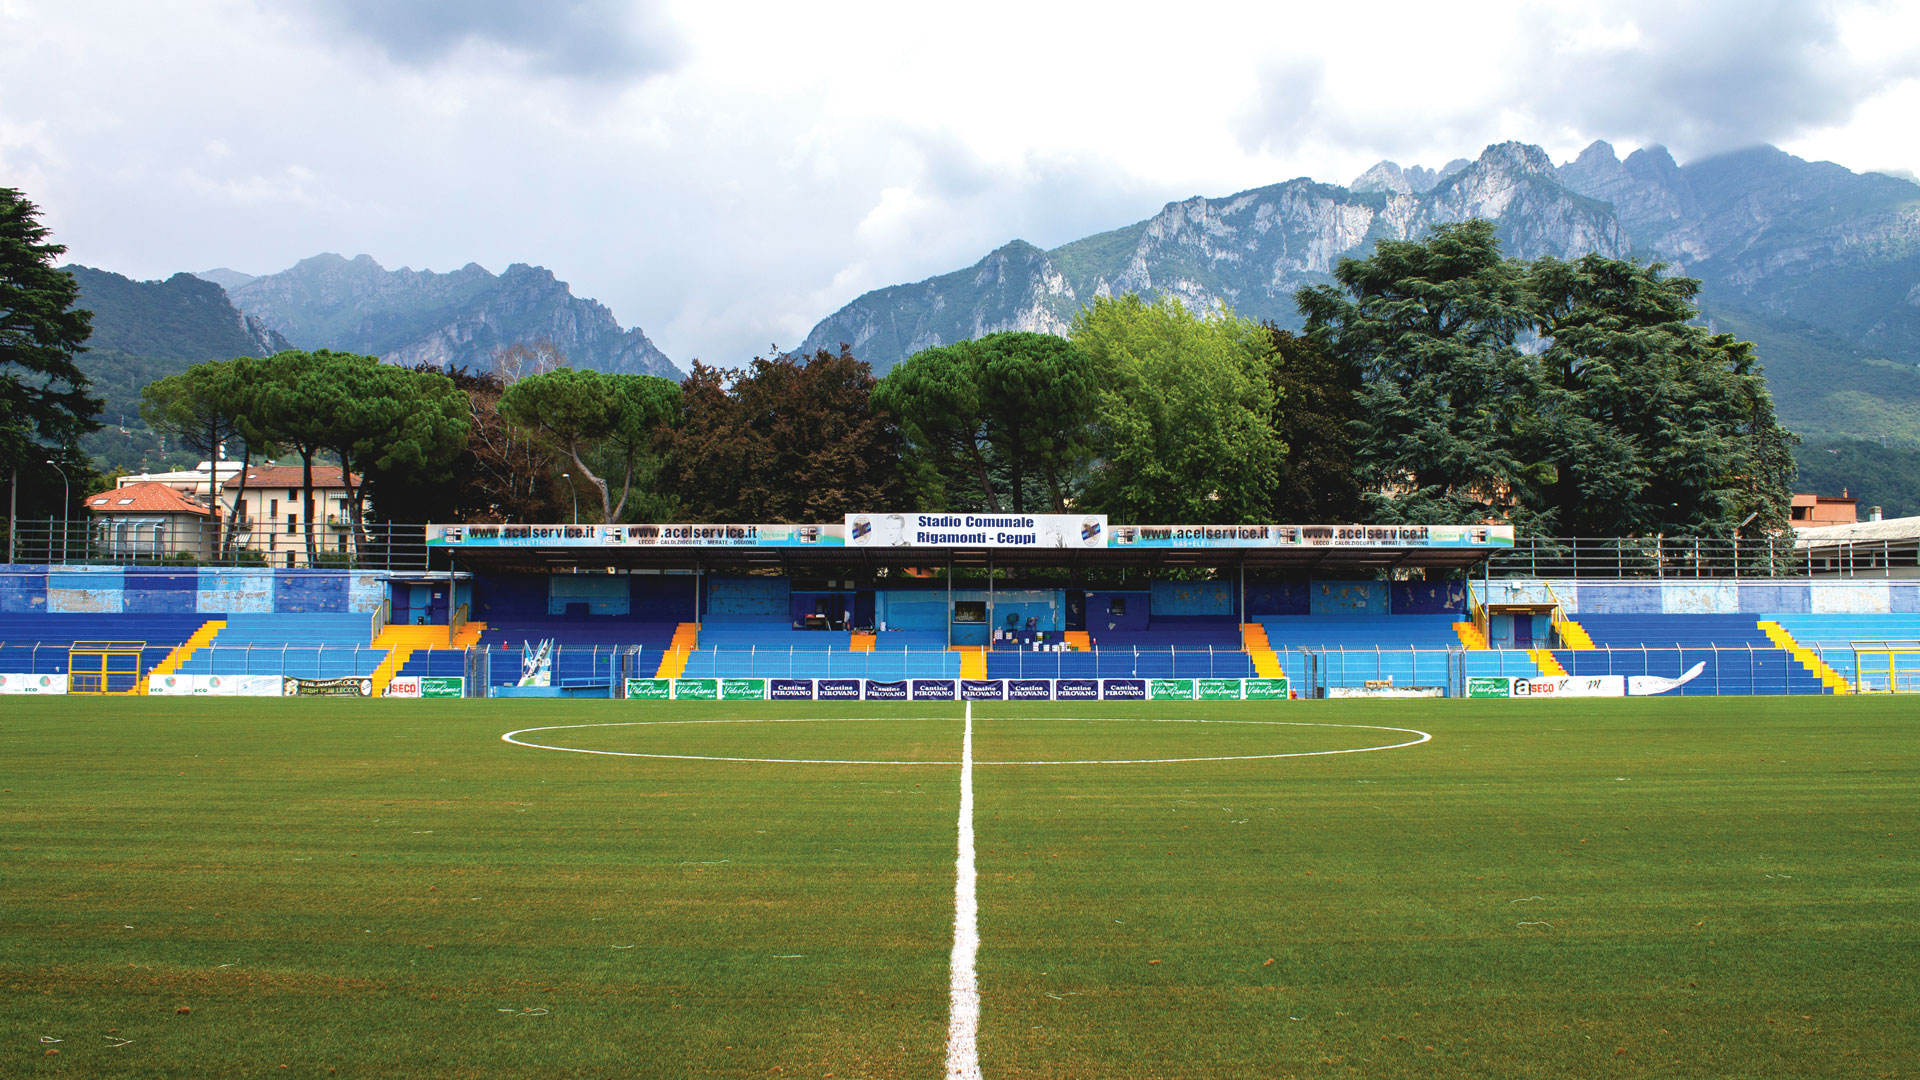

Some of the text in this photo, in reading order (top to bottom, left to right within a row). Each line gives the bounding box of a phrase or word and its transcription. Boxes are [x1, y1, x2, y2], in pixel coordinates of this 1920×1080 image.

[919, 516, 1034, 528] Stadio Comunale
[469, 526, 595, 538] www.acelservice.it
[628, 526, 757, 538] www.acelservice.it
[1141, 527, 1269, 540] www.acelservice.it
[1302, 527, 1428, 540] www.acelservice.it
[917, 532, 986, 545] Rigamonti
[997, 532, 1036, 545] Ceppi
[391, 683, 416, 693] SECO
[629, 686, 669, 696] VideoGames
[677, 686, 716, 696] VideoGames
[724, 686, 763, 696] VideoGames
[1200, 687, 1239, 696] VideoGames
[1247, 687, 1286, 696] VideoGames
